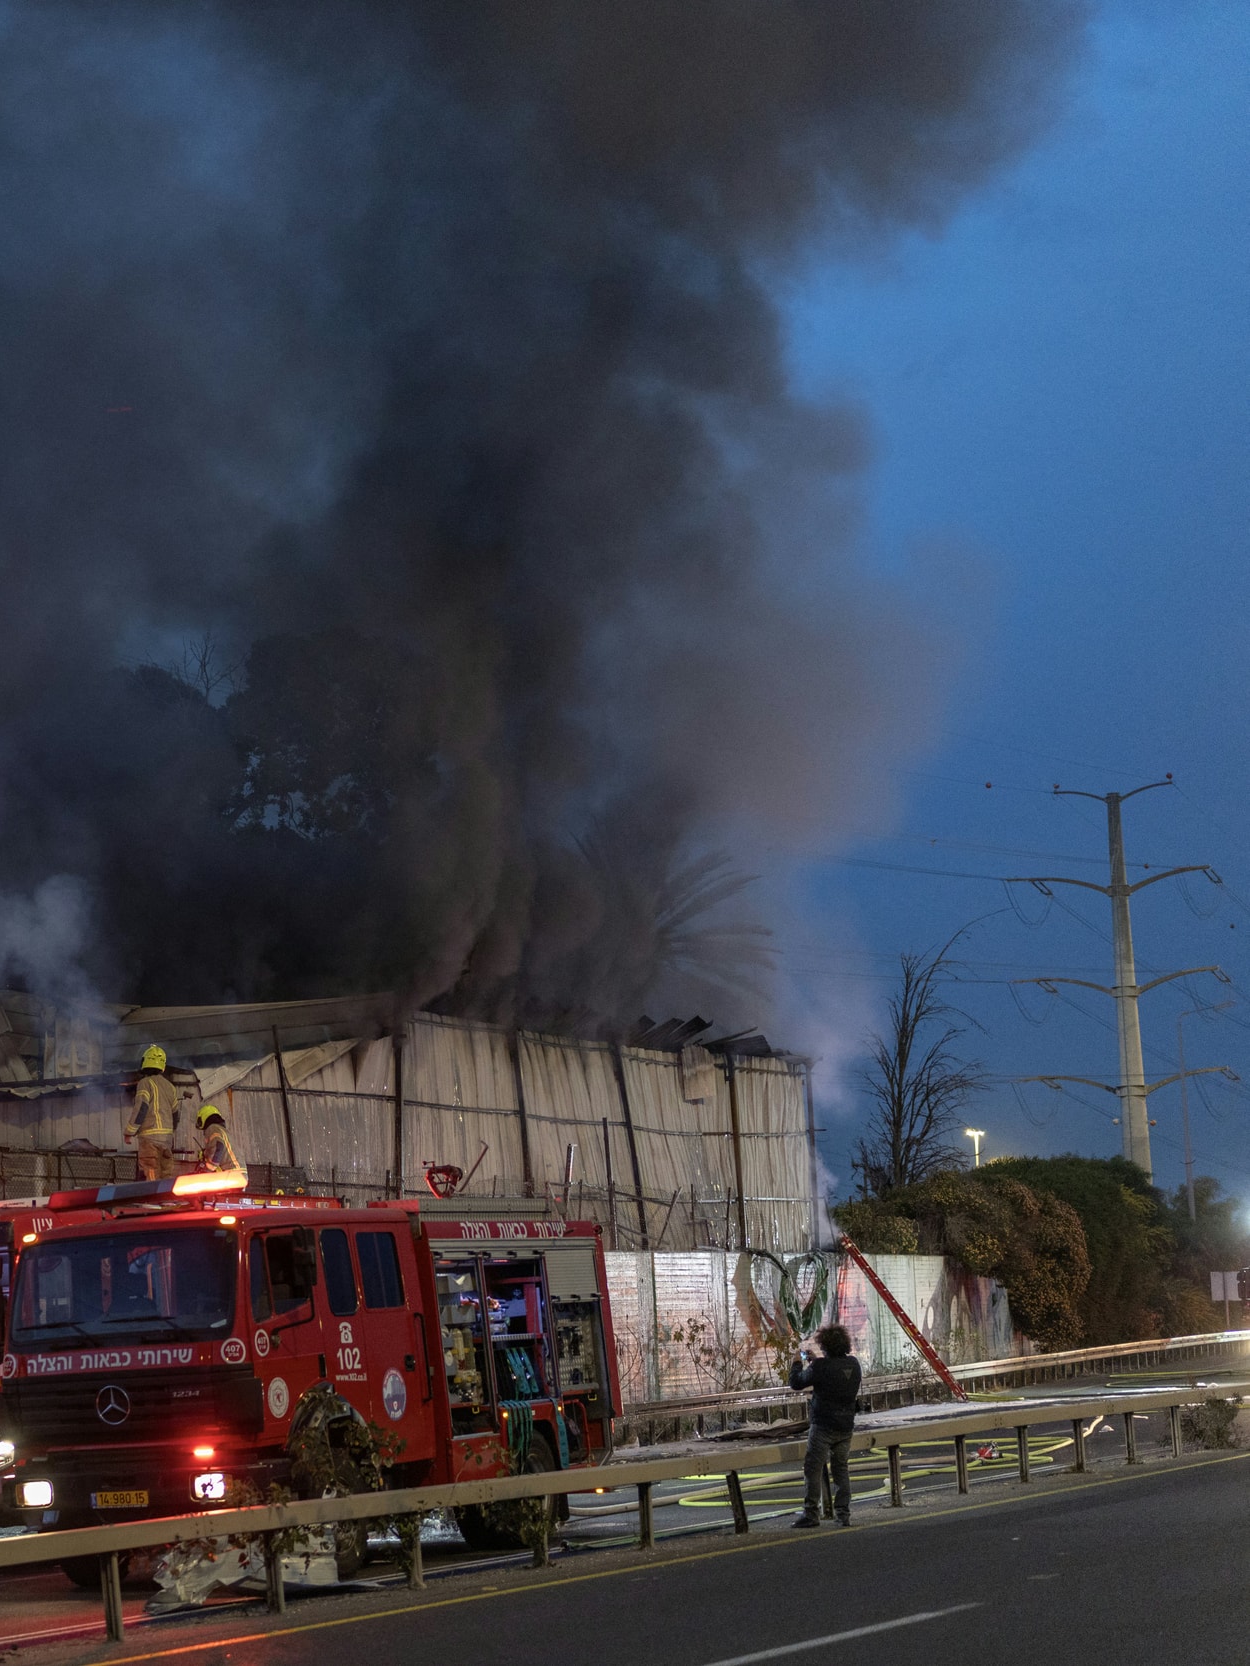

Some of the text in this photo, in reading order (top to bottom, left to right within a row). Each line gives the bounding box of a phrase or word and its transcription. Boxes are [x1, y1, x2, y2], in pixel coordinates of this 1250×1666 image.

[460, 1219, 566, 1239] שירותי כבאות והצלה
[225, 1344, 241, 1352] 407
[27, 1348, 192, 1375] שירותי כבאות והצלה
[336, 1347, 362, 1370] 102
[335, 1372, 367, 1382] www.102.co.il
